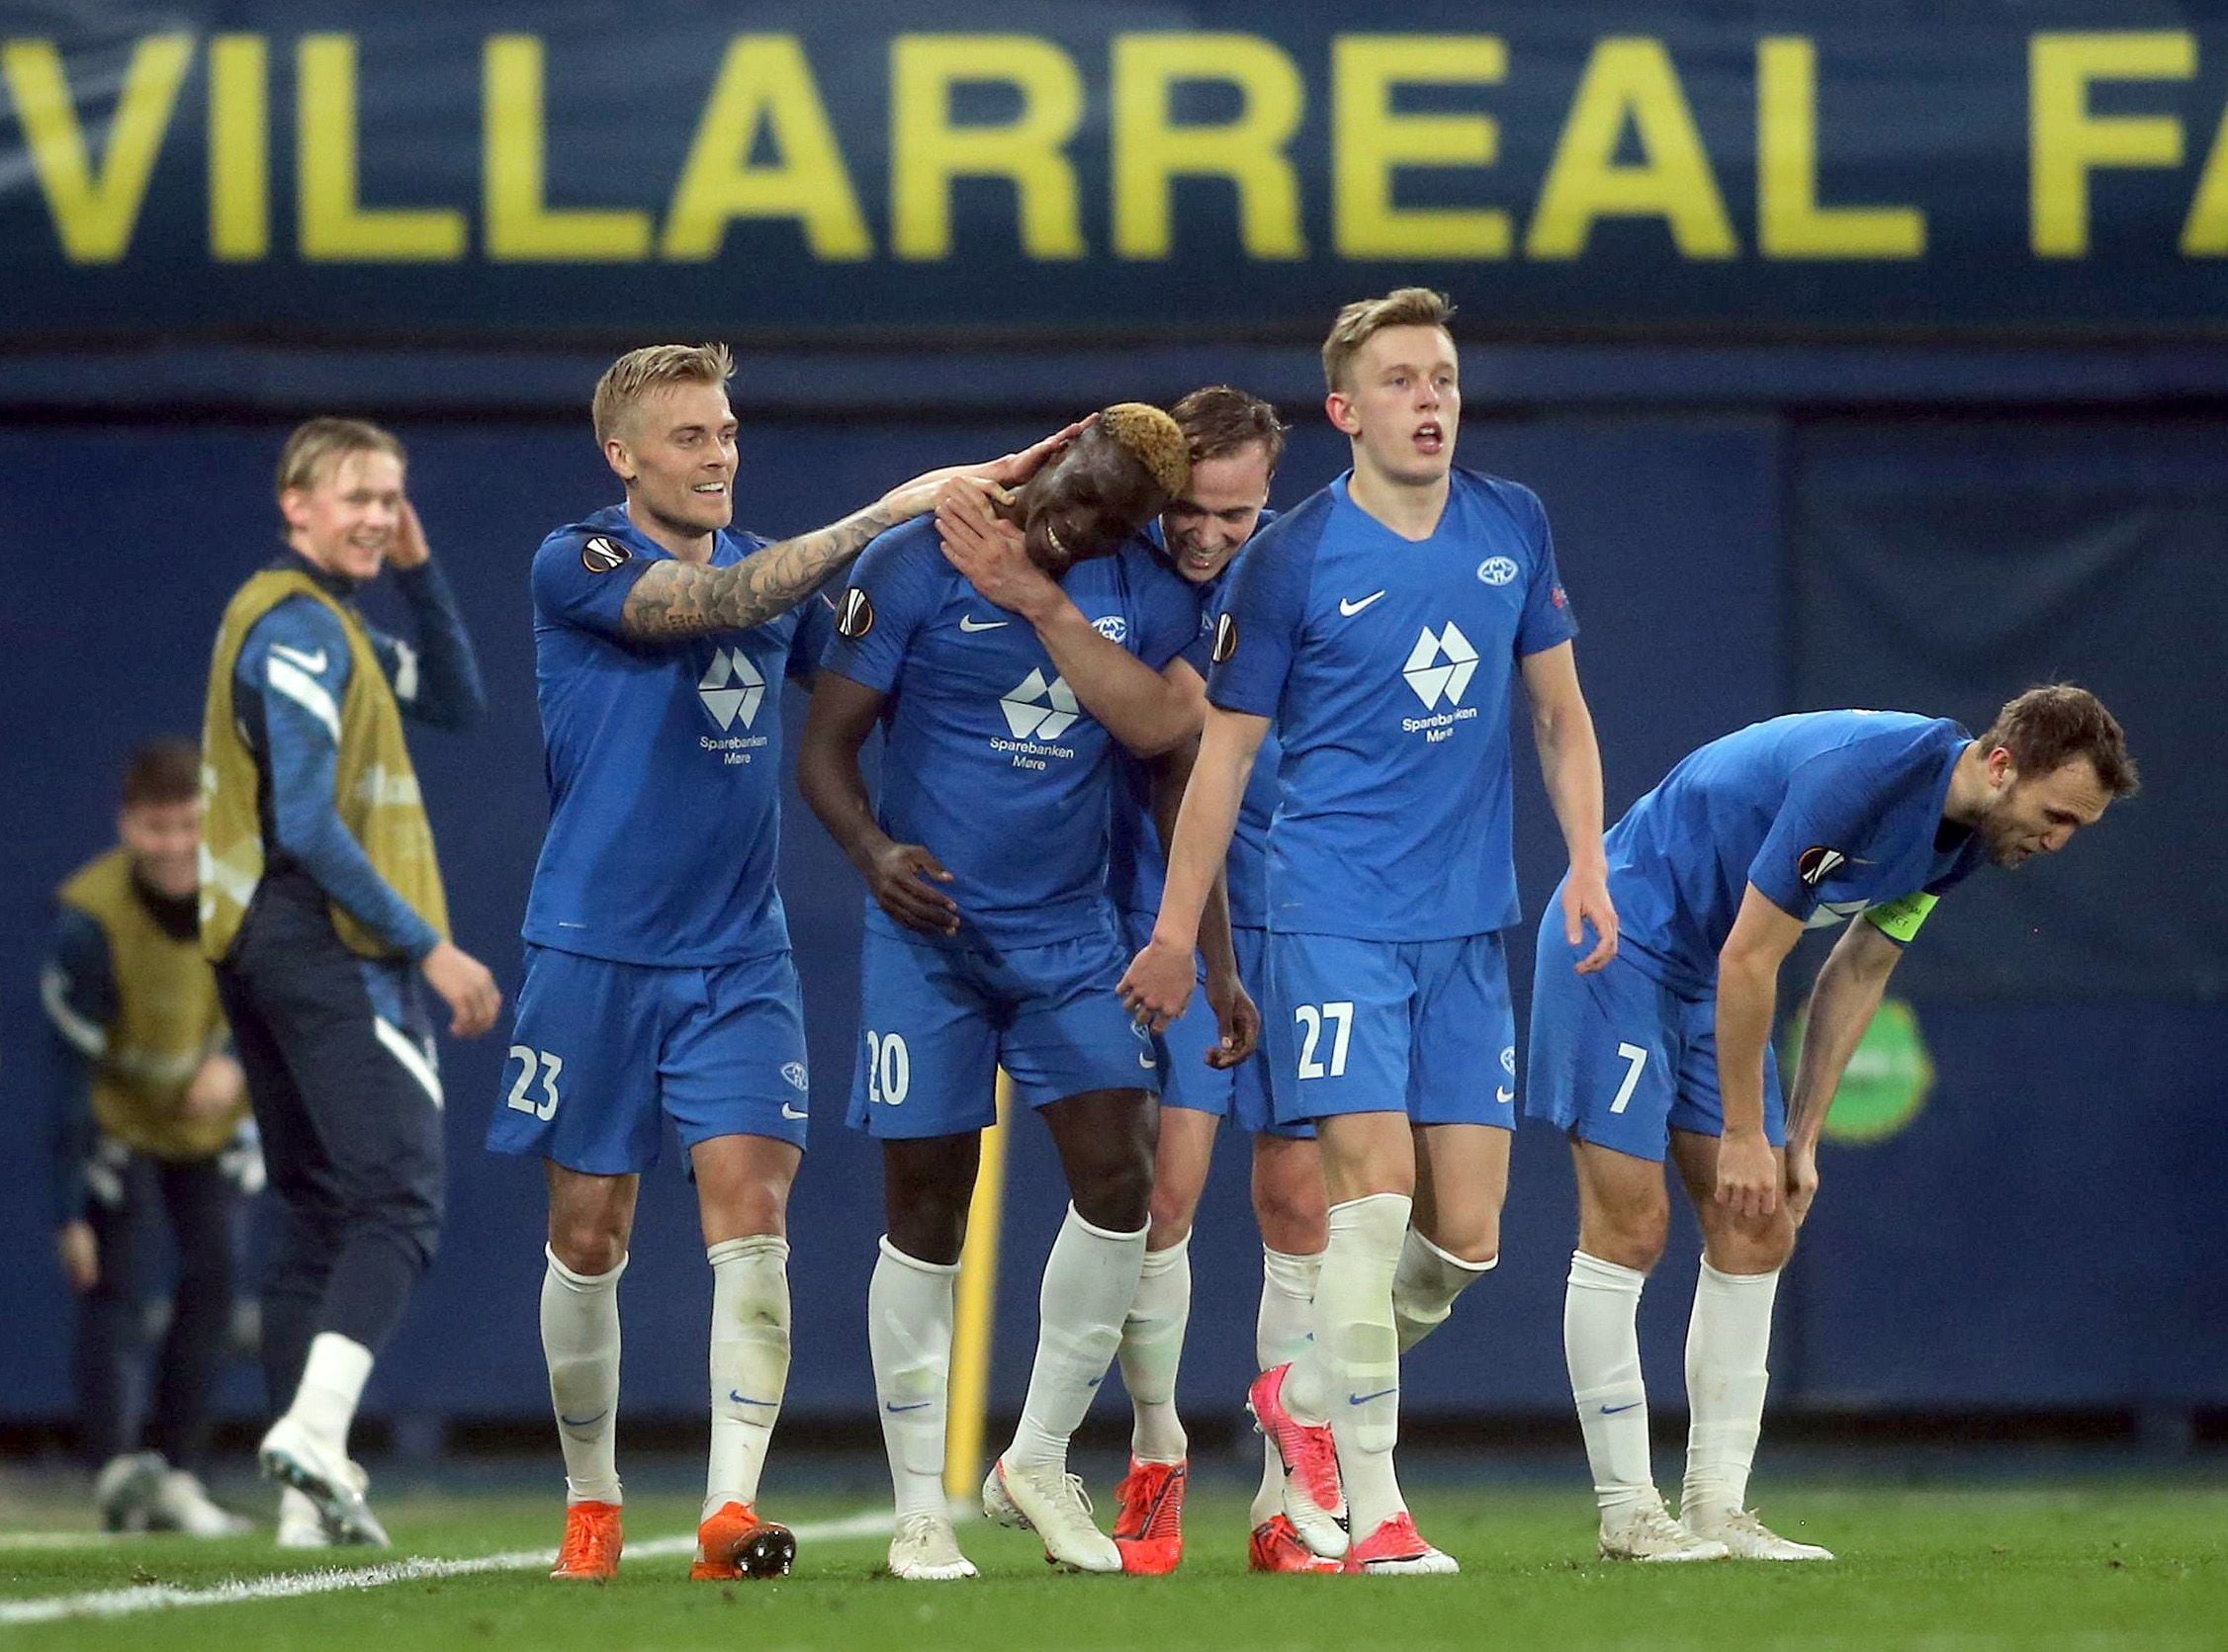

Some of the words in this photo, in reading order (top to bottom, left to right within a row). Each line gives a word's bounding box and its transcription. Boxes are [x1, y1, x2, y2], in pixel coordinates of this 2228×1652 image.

[2, 35, 1924, 260] VILLARREAL
[2030, 31, 2228, 259] F
[990, 736, 1074, 759] Sparebanken
[867, 1029, 909, 1105] 20
[1294, 1001, 1354, 1081] 27
[1609, 1041, 1649, 1114] 7
[507, 1044, 563, 1121] 23
